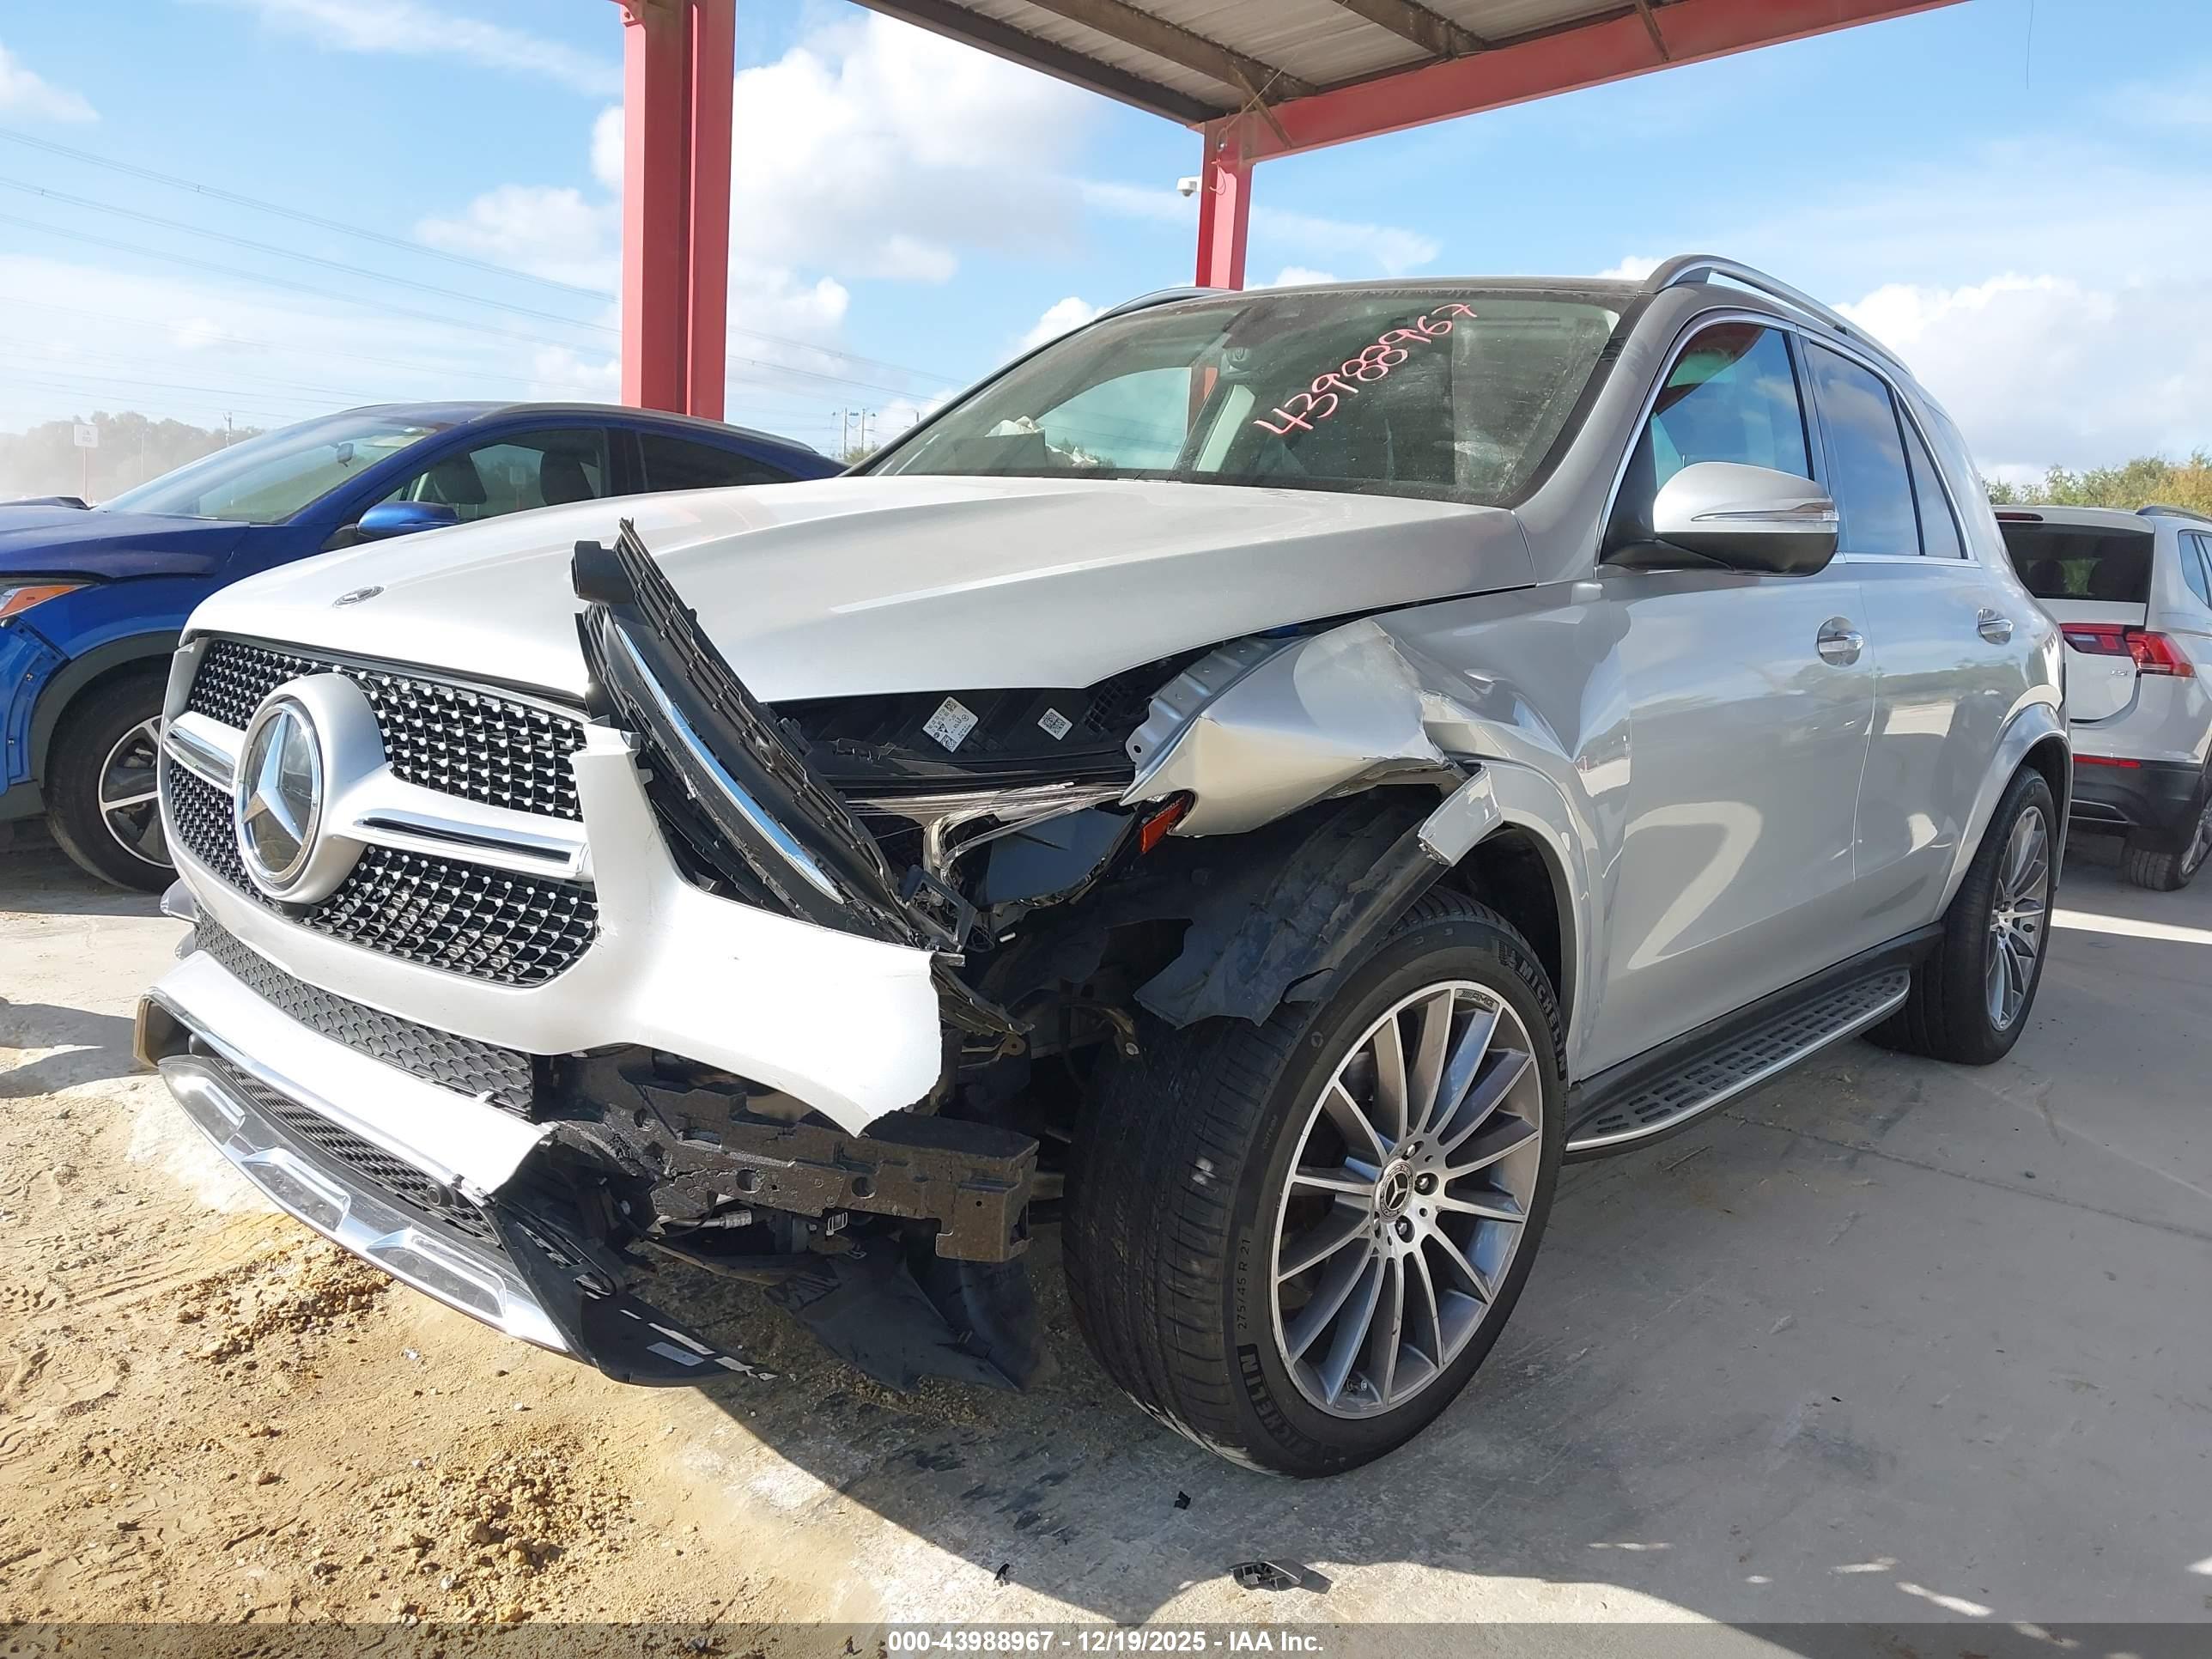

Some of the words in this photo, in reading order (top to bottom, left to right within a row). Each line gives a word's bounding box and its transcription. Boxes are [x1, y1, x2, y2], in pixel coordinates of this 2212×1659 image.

[1252, 303, 1478, 435] 43988967
[1519, 960, 1567, 1073] MICHELIN
[1238, 1261, 1249, 1272] R
[1240, 1238, 1251, 1255] 21
[1237, 1277, 1249, 1330] 275/45
